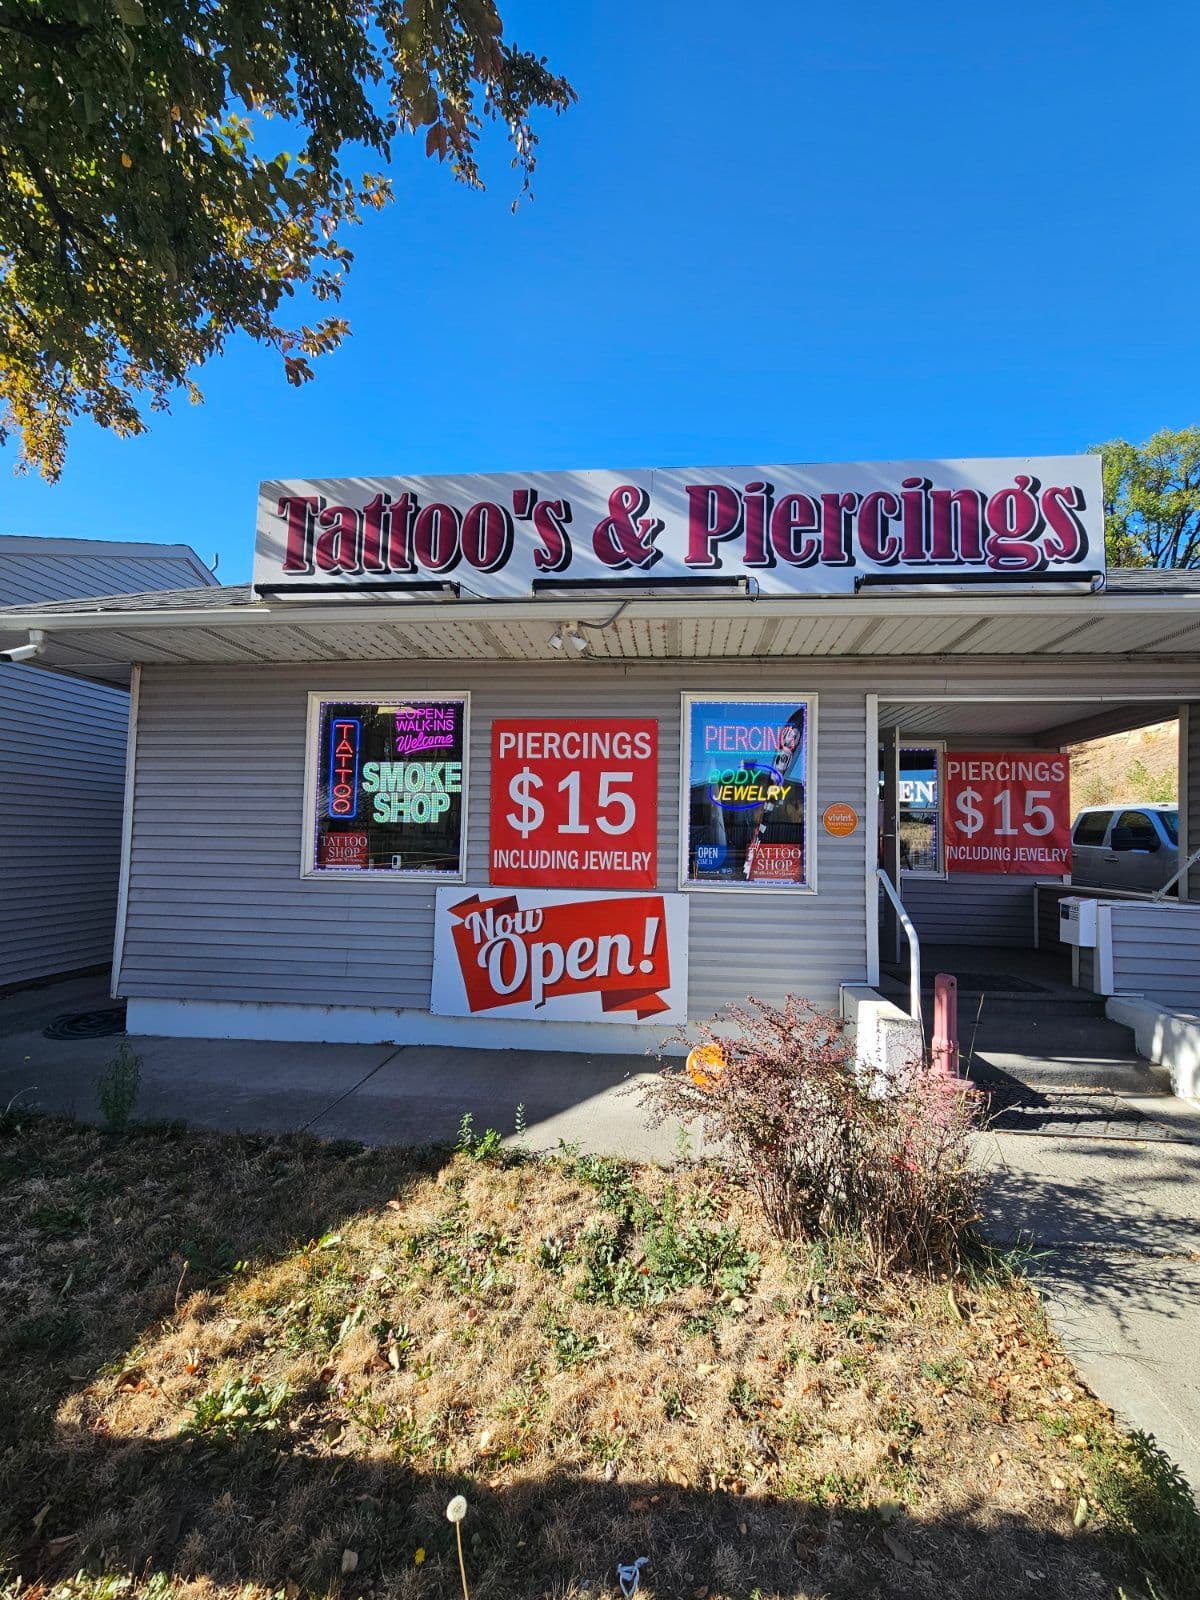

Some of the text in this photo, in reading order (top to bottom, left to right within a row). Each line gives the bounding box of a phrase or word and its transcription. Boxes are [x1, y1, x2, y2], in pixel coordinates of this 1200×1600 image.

[278, 474, 1089, 575] Tattoo's & Piercings
[405, 708, 444, 720] OPEN
[396, 719, 455, 732] WALK-INS
[396, 731, 454, 752] Welcome
[499, 731, 652, 760] PIERCINGS
[705, 725, 796, 753] PIERCING
[332, 724, 355, 813] TATTOO
[362, 761, 462, 793] SMOKE
[708, 768, 761, 785] BODY
[948, 761, 1065, 783] PIERCINGS
[712, 785, 792, 801] JEWELRY
[898, 780, 937, 803] EN
[373, 792, 451, 824] SHOP
[320, 835, 368, 847] TATTOO
[328, 846, 361, 858] SHOP
[493, 849, 652, 872] INCLUDING JEWELRY
[698, 846, 719, 859] OPEN
[748, 847, 802, 860] TATTOO
[946, 845, 1068, 863] INCLUDING JEWELRY
[757, 859, 793, 871] SHOP
[464, 908, 543, 945] Now
[477, 917, 660, 1007] Open!
